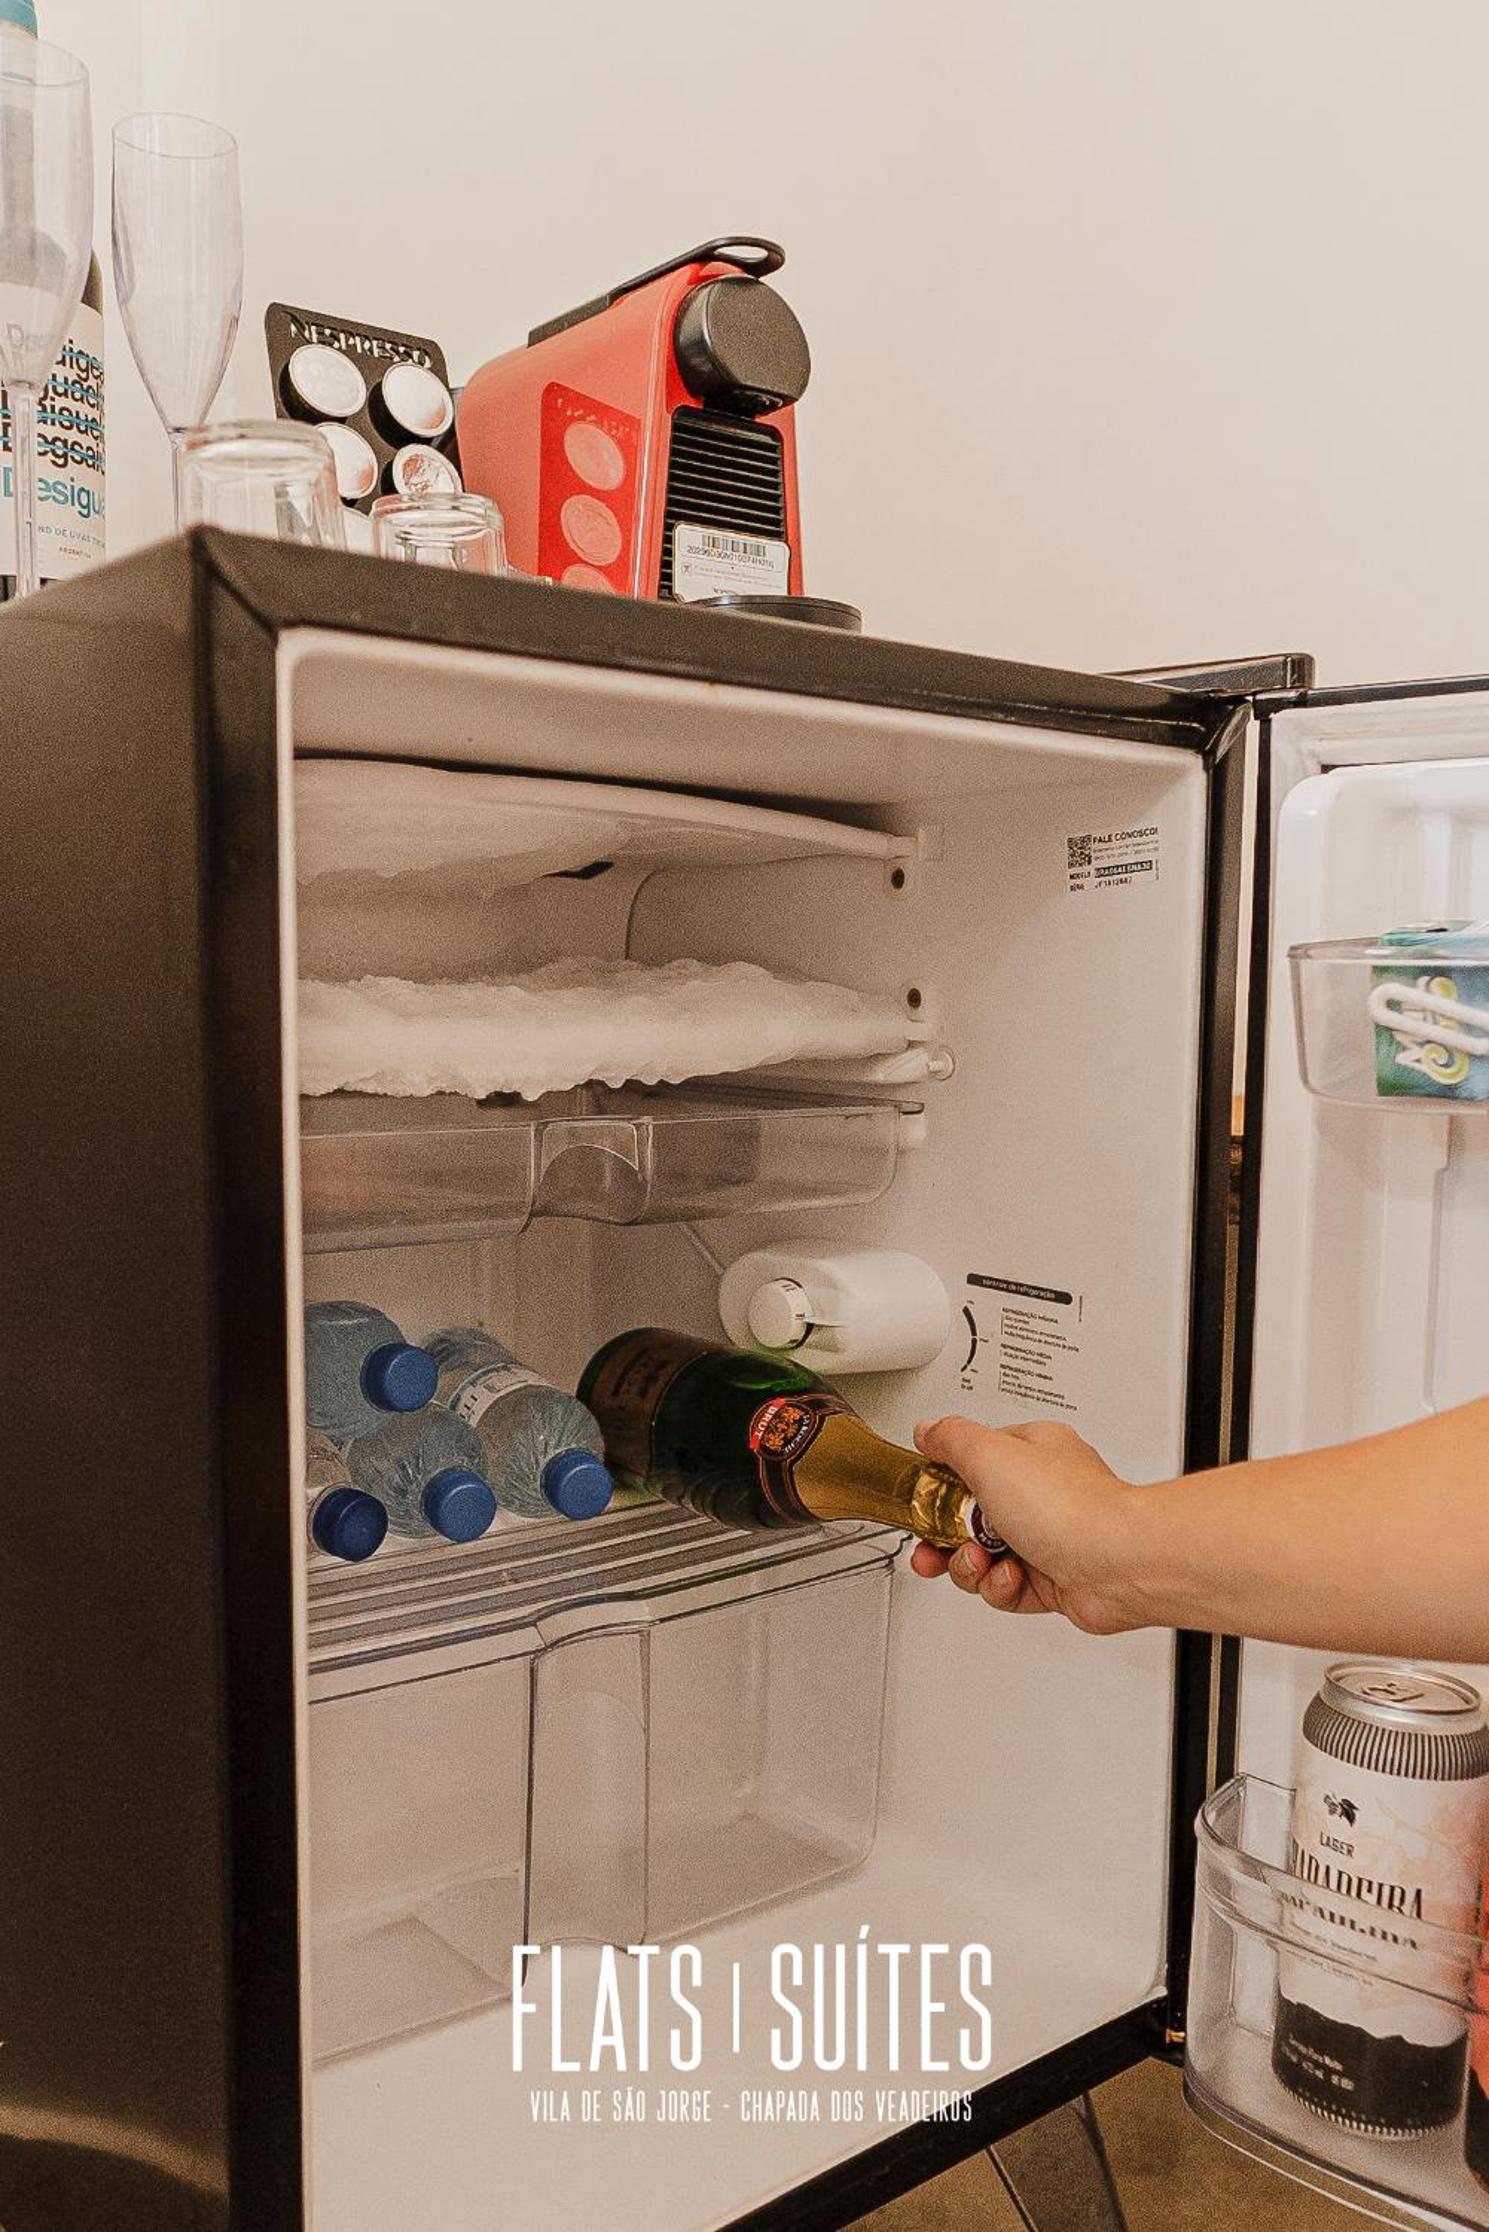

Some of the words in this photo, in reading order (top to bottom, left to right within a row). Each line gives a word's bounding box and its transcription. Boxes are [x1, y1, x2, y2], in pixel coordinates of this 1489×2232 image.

[281, 311, 432, 369] NESPRESSO
[754, 1406, 779, 1440] BRUT
[1319, 1830, 1355, 1858] LAGER
